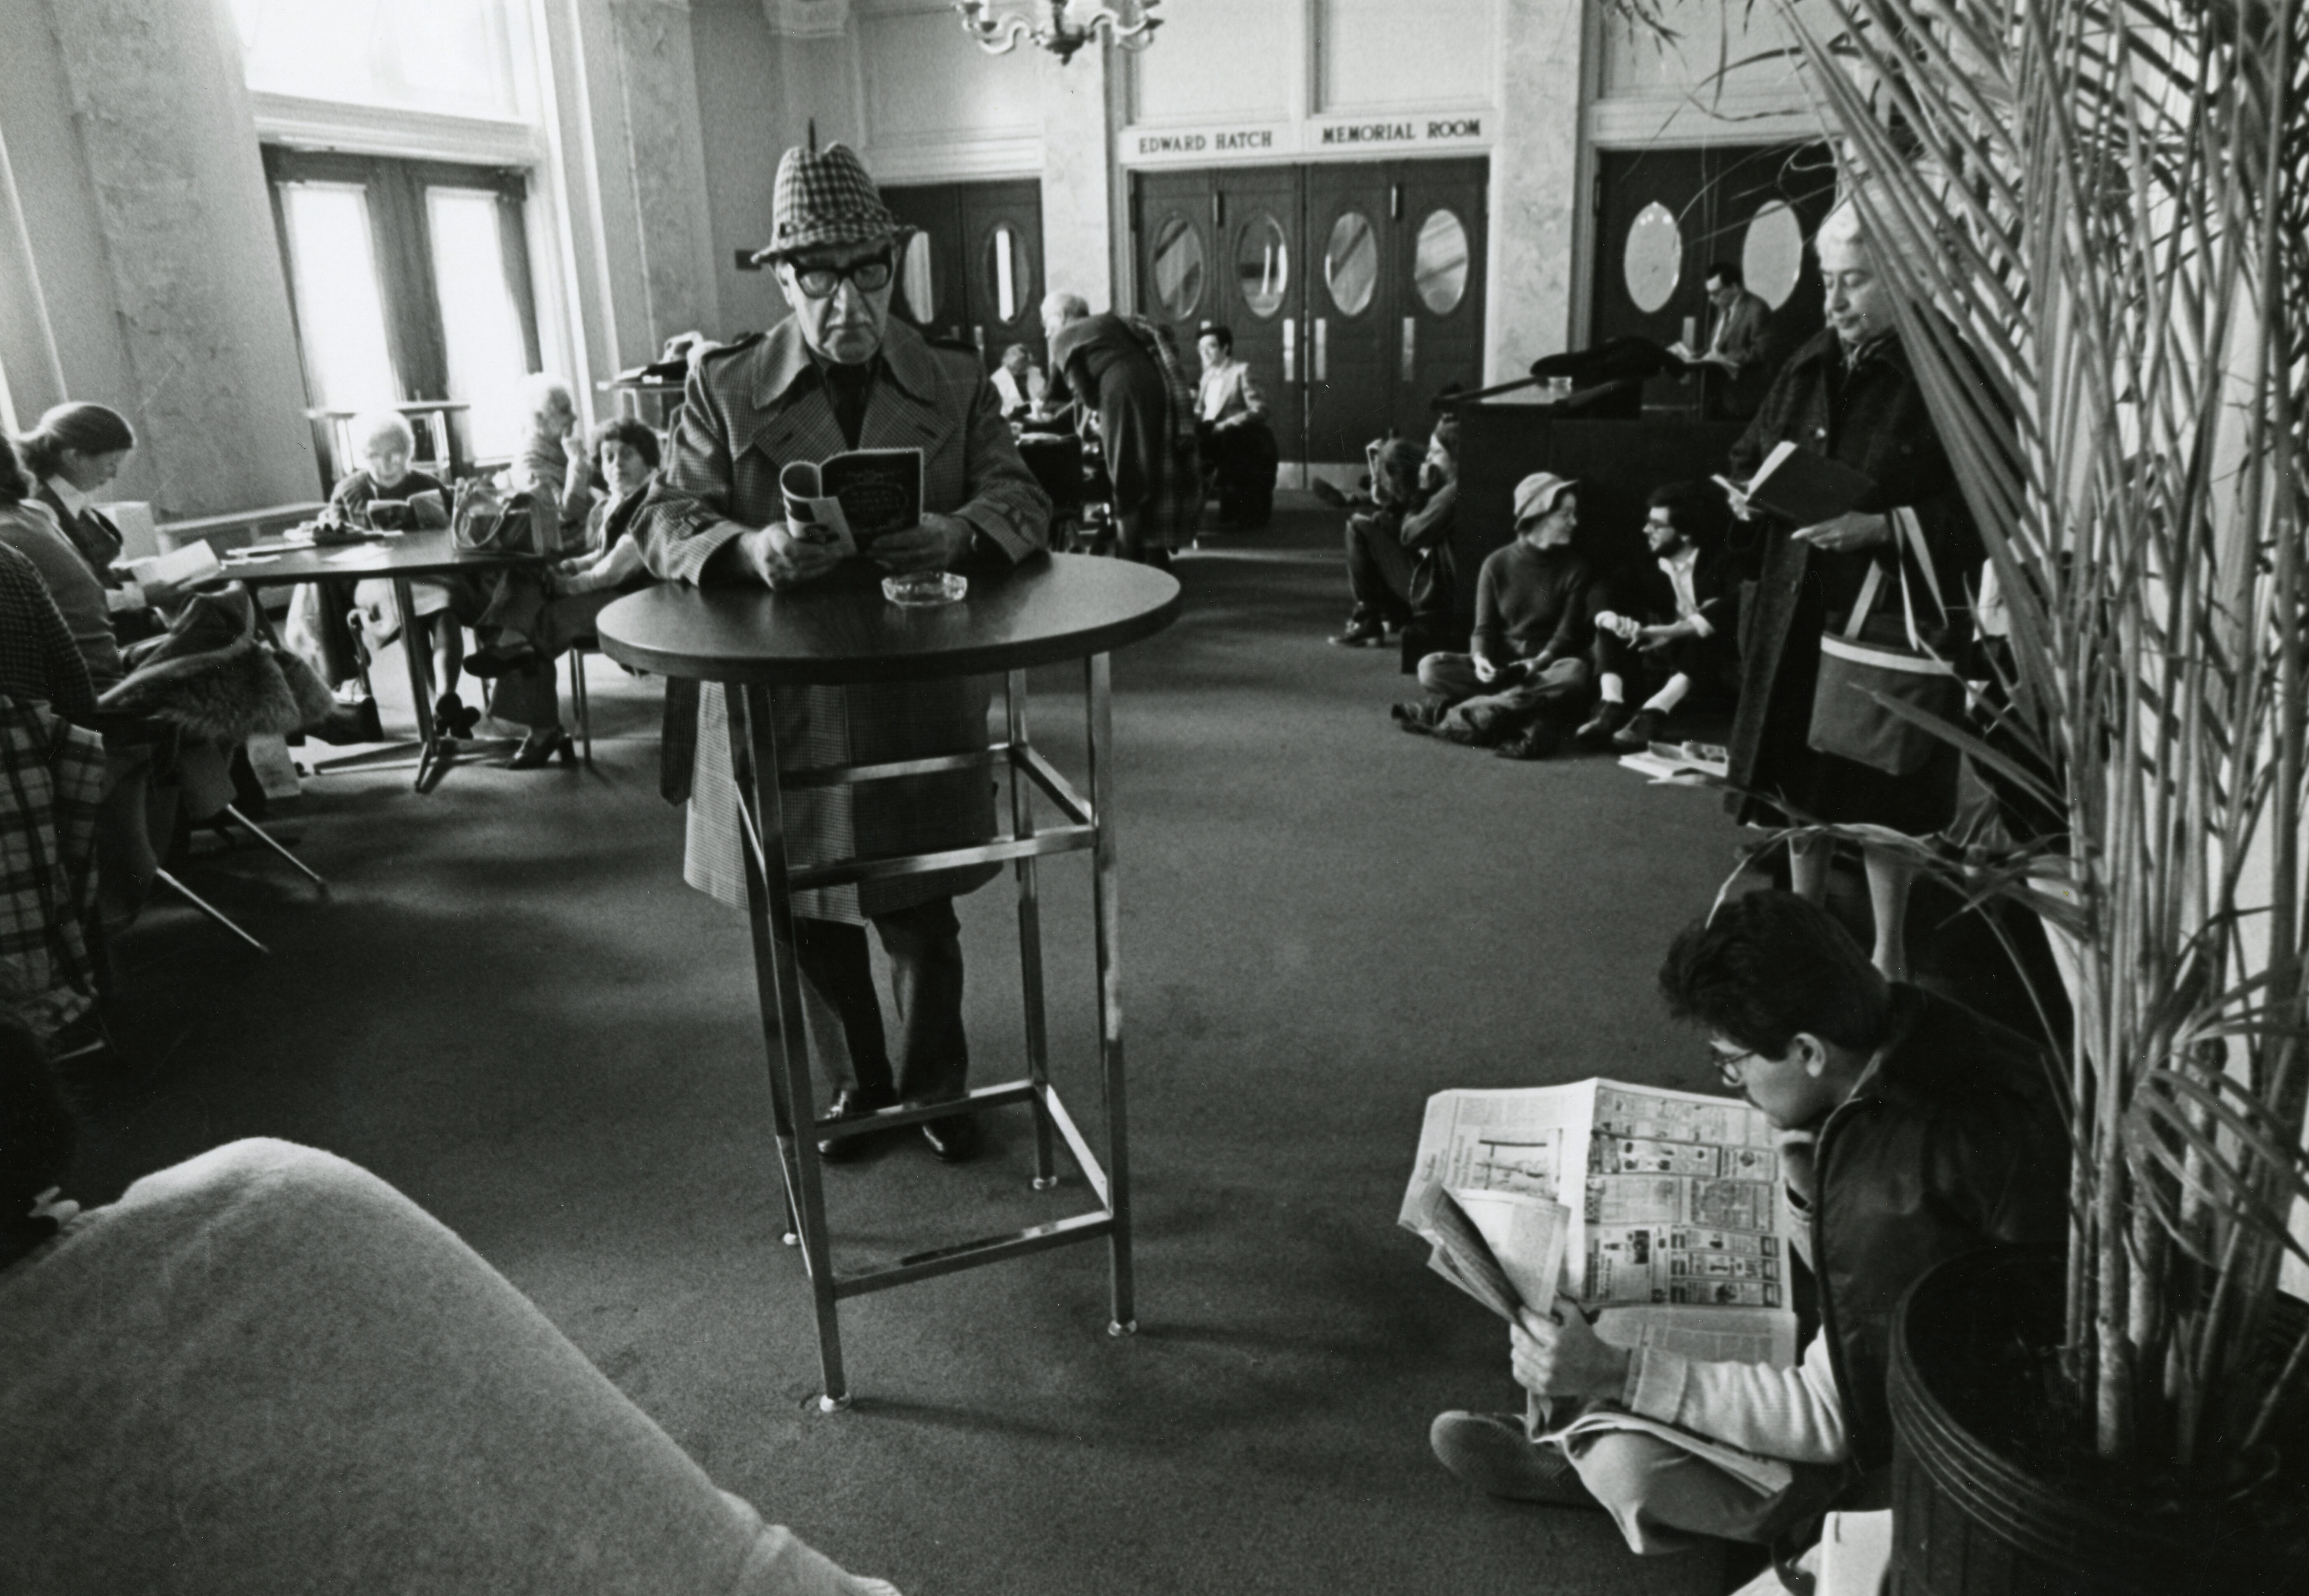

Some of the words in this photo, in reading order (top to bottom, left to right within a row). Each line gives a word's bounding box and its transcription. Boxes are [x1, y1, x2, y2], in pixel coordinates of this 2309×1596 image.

[1139, 134, 1206, 154] EDWARD
[1215, 130, 1272, 150] HATCH
[1322, 122, 1415, 144] MEMORIAL
[1427, 119, 1480, 138] ROOM
